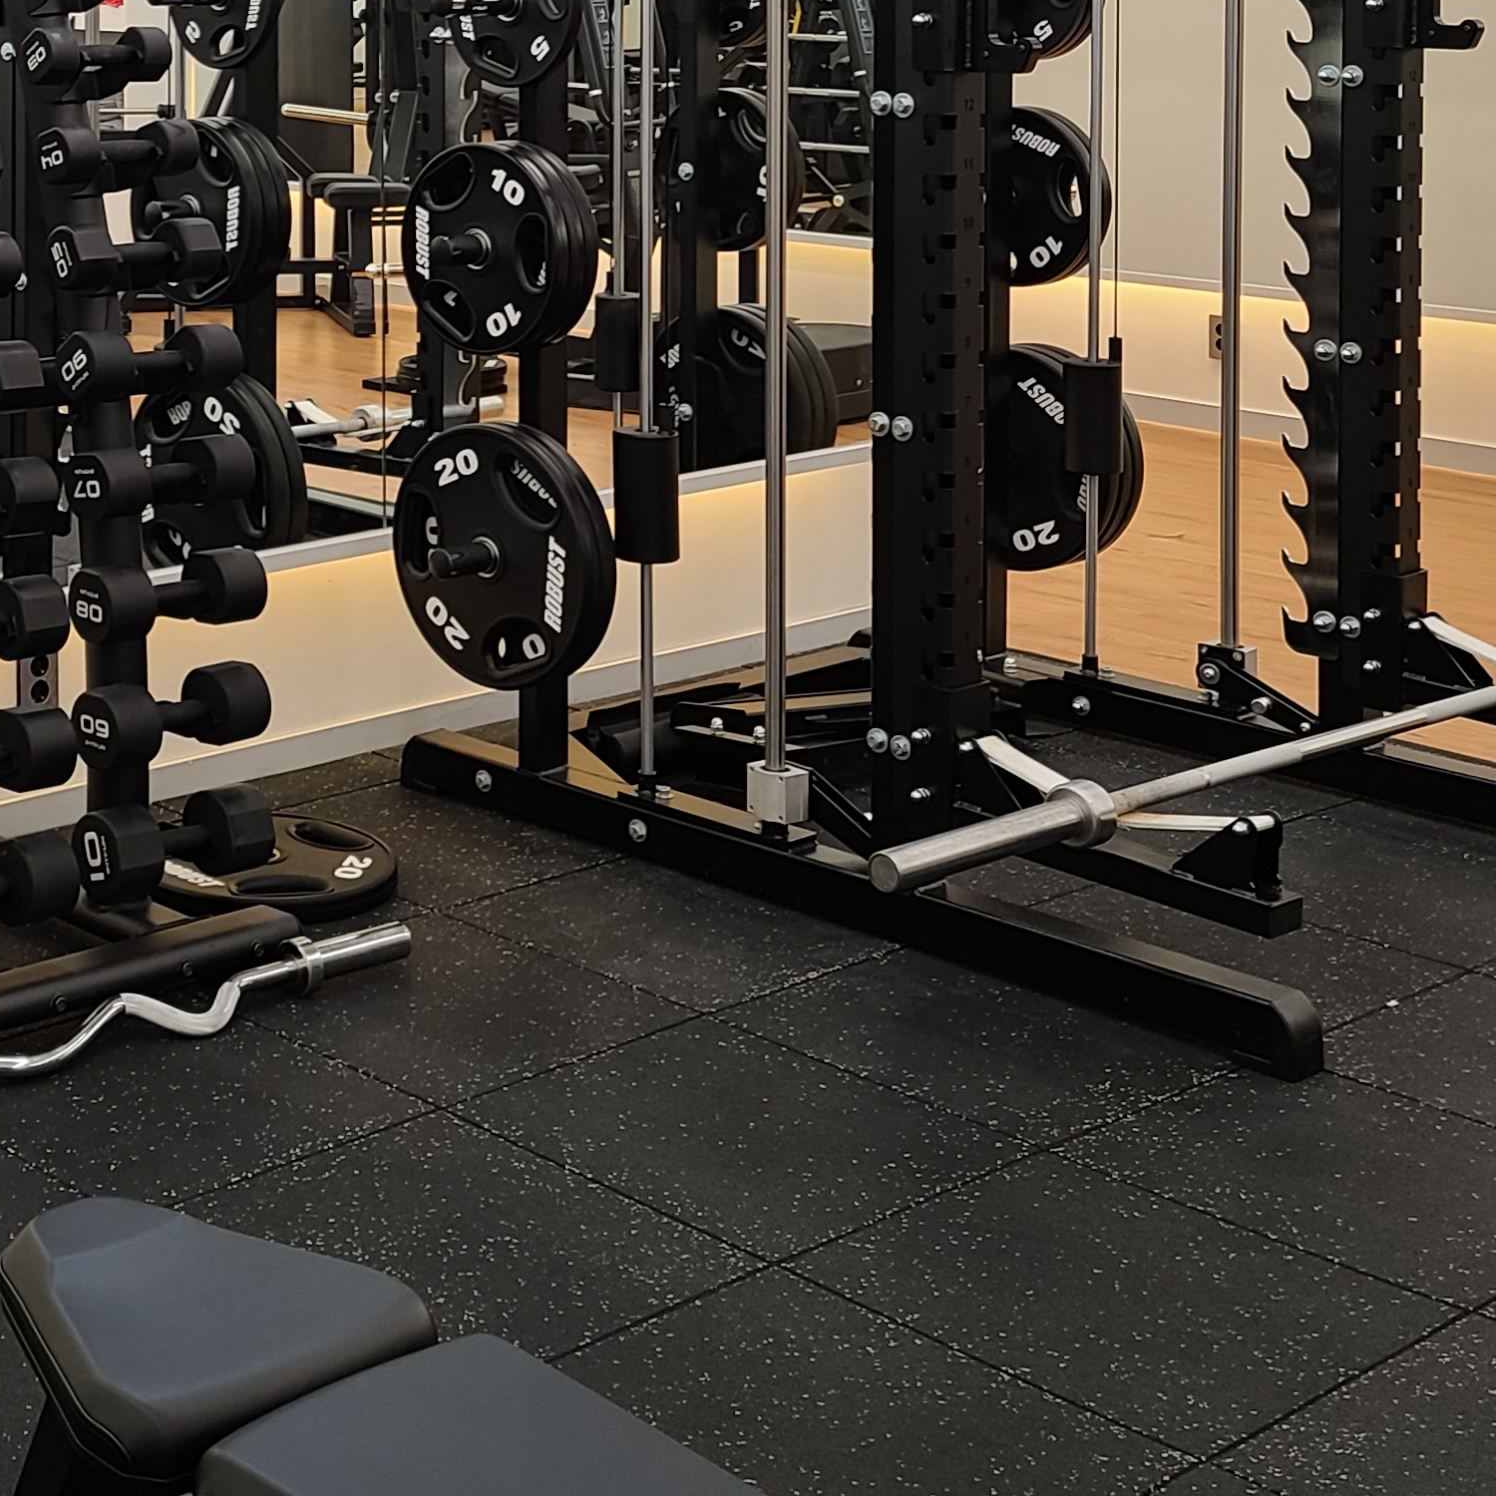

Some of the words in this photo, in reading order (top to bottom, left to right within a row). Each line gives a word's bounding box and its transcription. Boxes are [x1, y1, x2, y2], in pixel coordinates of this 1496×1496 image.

[1033, 19, 1054, 42] 5
[530, 35, 551, 62] 5
[964, 98, 975, 112] 12
[1011, 124, 1061, 158] ROBUS
[490, 168, 525, 206] 10
[415, 205, 430, 280] ROBUST
[1029, 235, 1064, 269] 10
[486, 303, 522, 338] 10
[1017, 377, 1065, 425] BUST
[434, 448, 479, 487] 20
[1012, 519, 1060, 552] 20
[543, 535, 566, 633] ROBUST
[425, 596, 470, 651] 20
[334, 854, 373, 880] 20
